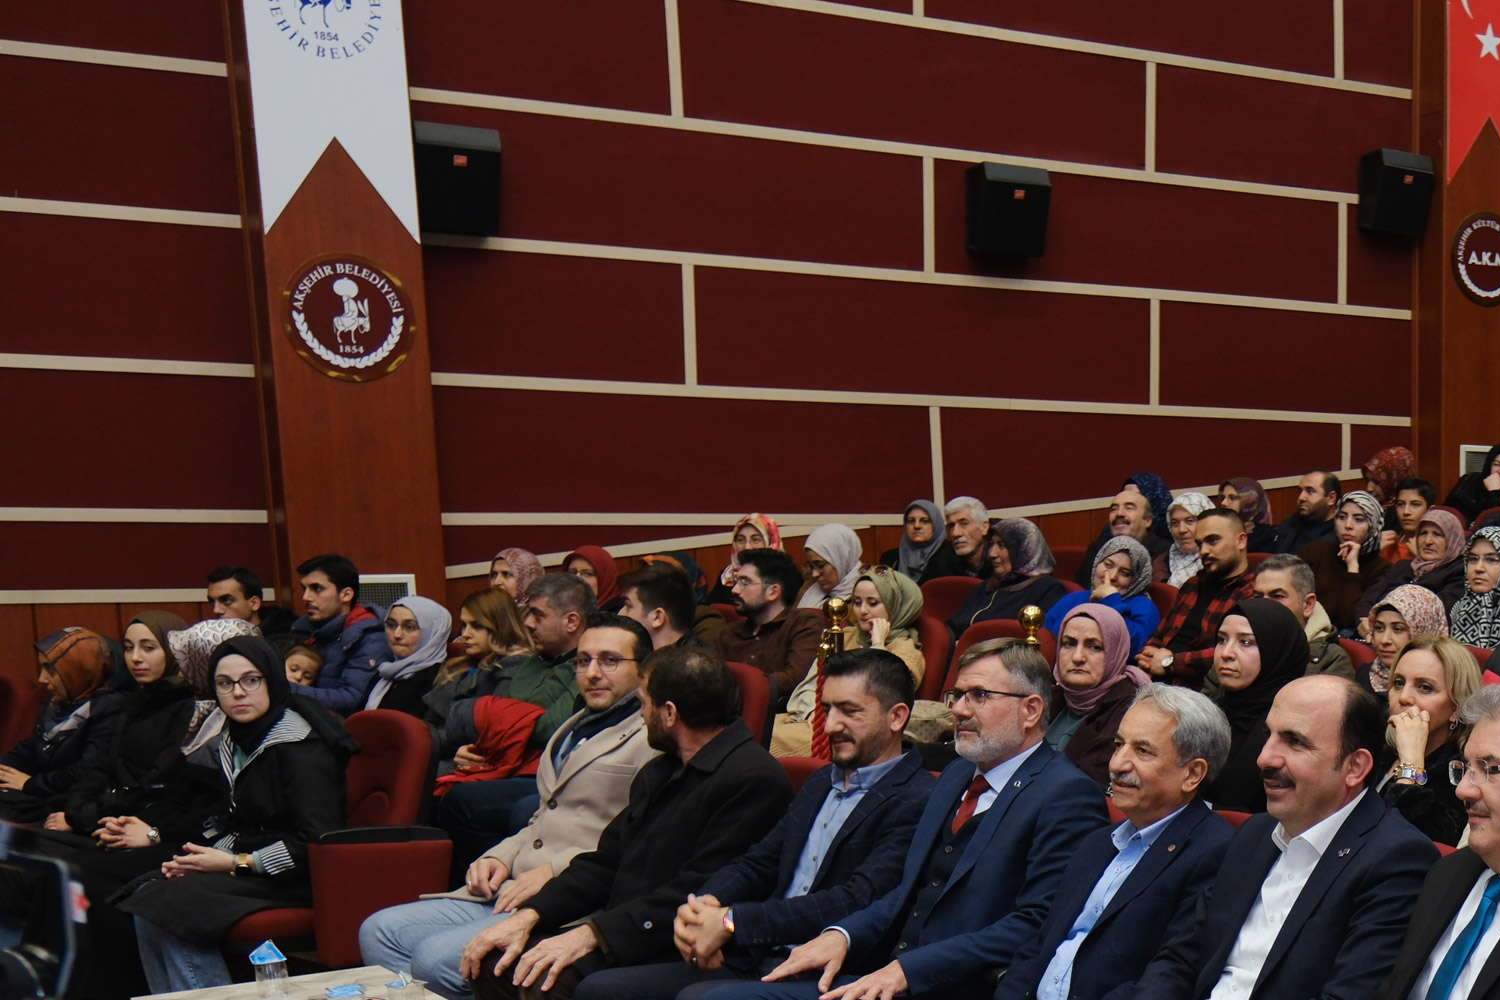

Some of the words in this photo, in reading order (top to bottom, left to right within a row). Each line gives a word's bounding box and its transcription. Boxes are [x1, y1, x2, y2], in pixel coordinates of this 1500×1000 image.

[268, 0, 309, 51] EHİR
[314, 31, 339, 41] 1854
[292, 264, 334, 310] AKŞEHİR
[335, 263, 405, 313] BELEDİYESİ
[339, 345, 364, 354] 1854
